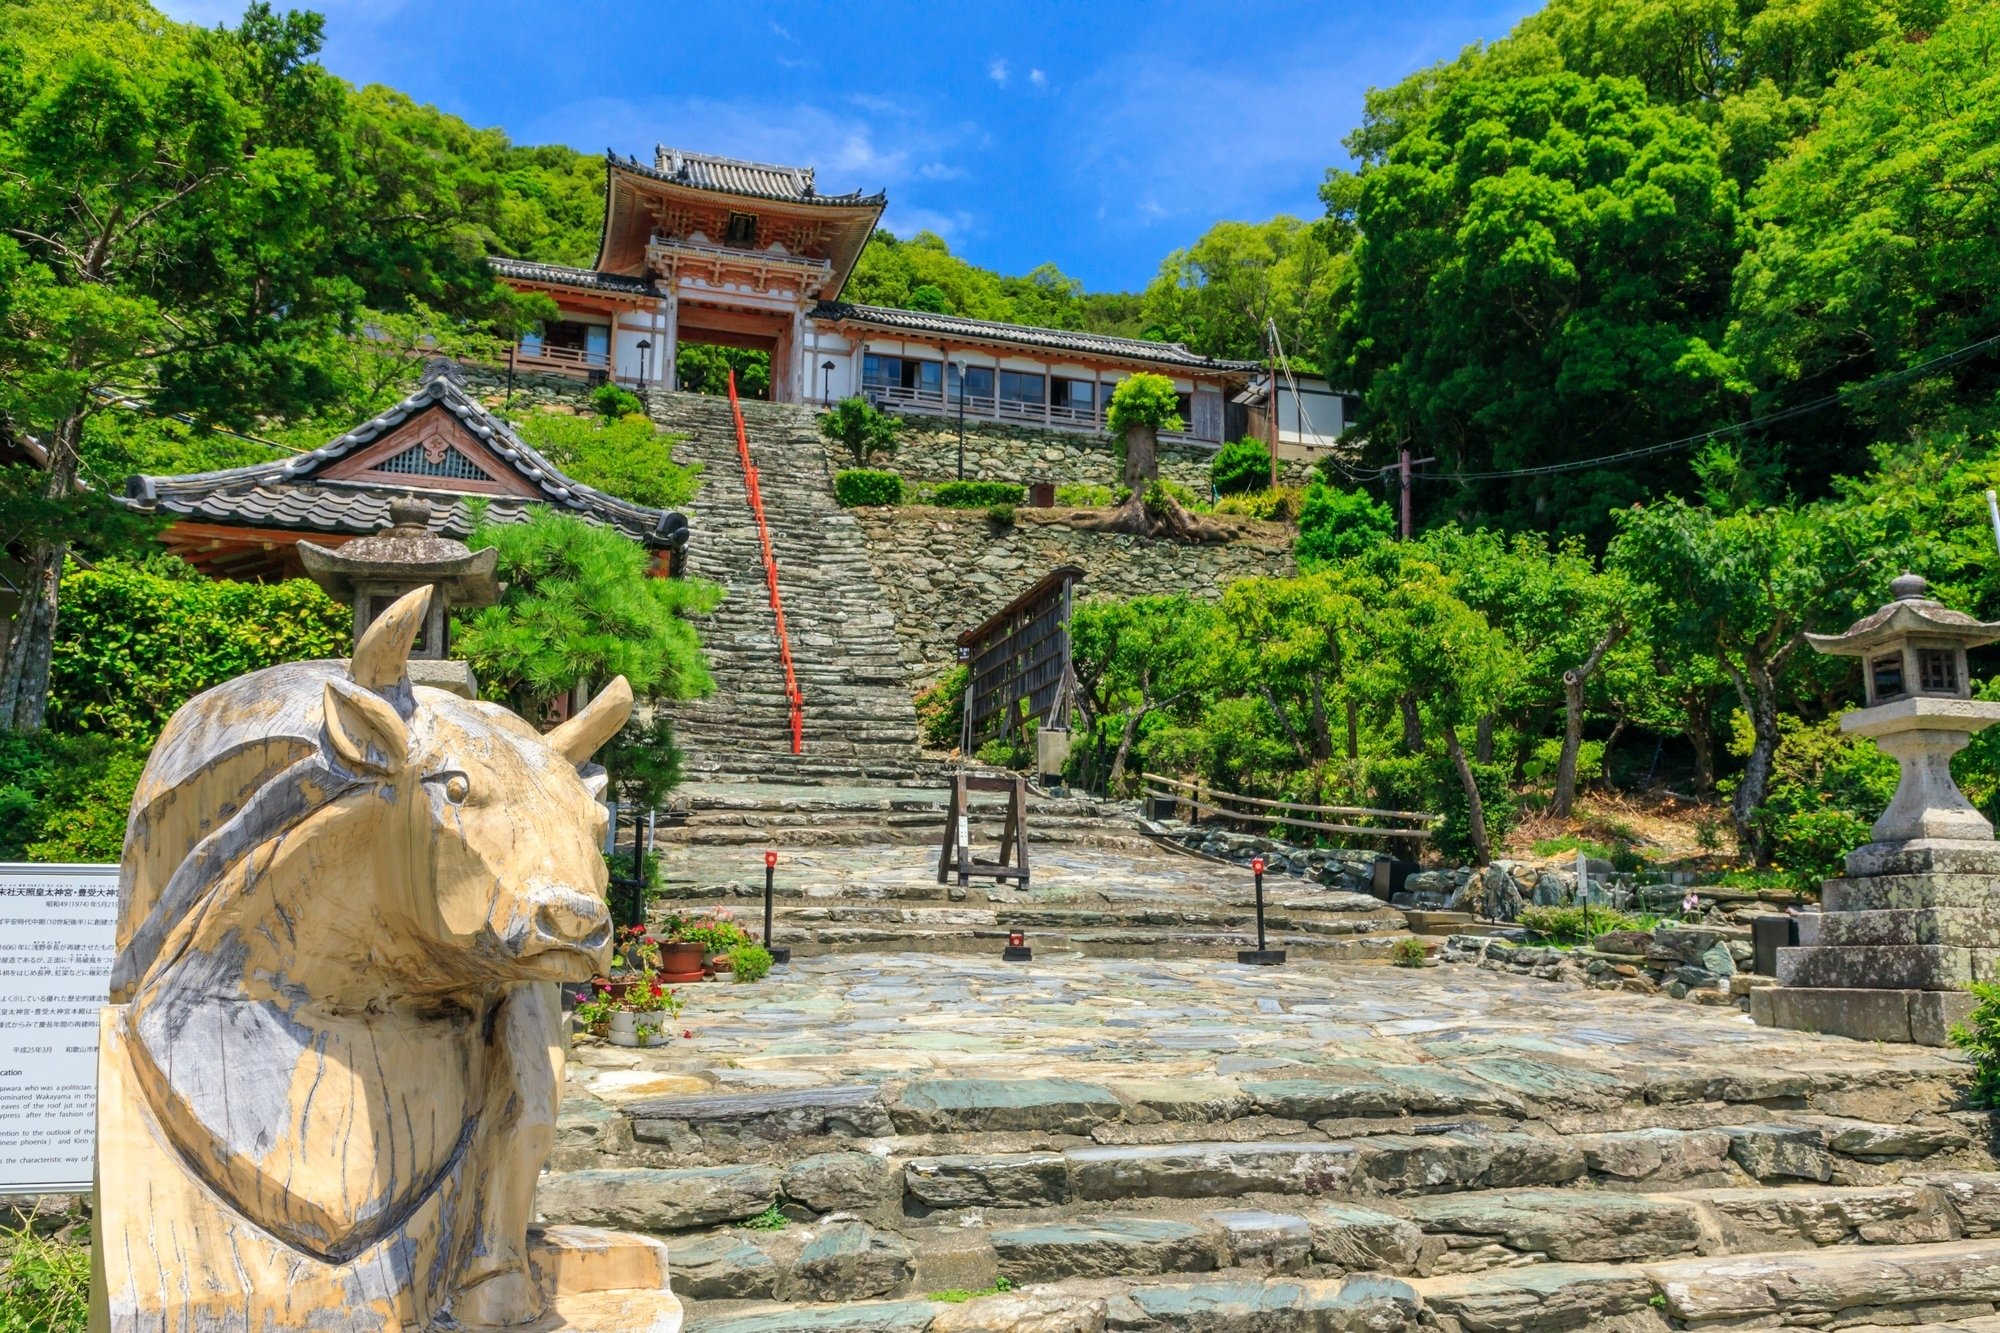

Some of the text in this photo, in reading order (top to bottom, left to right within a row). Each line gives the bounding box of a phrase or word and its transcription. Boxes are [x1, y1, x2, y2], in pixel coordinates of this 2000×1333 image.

[61, 1084, 91, 1092] politician
[64, 1102, 73, 1110] jut
[20, 1156, 62, 1164] characteristic
